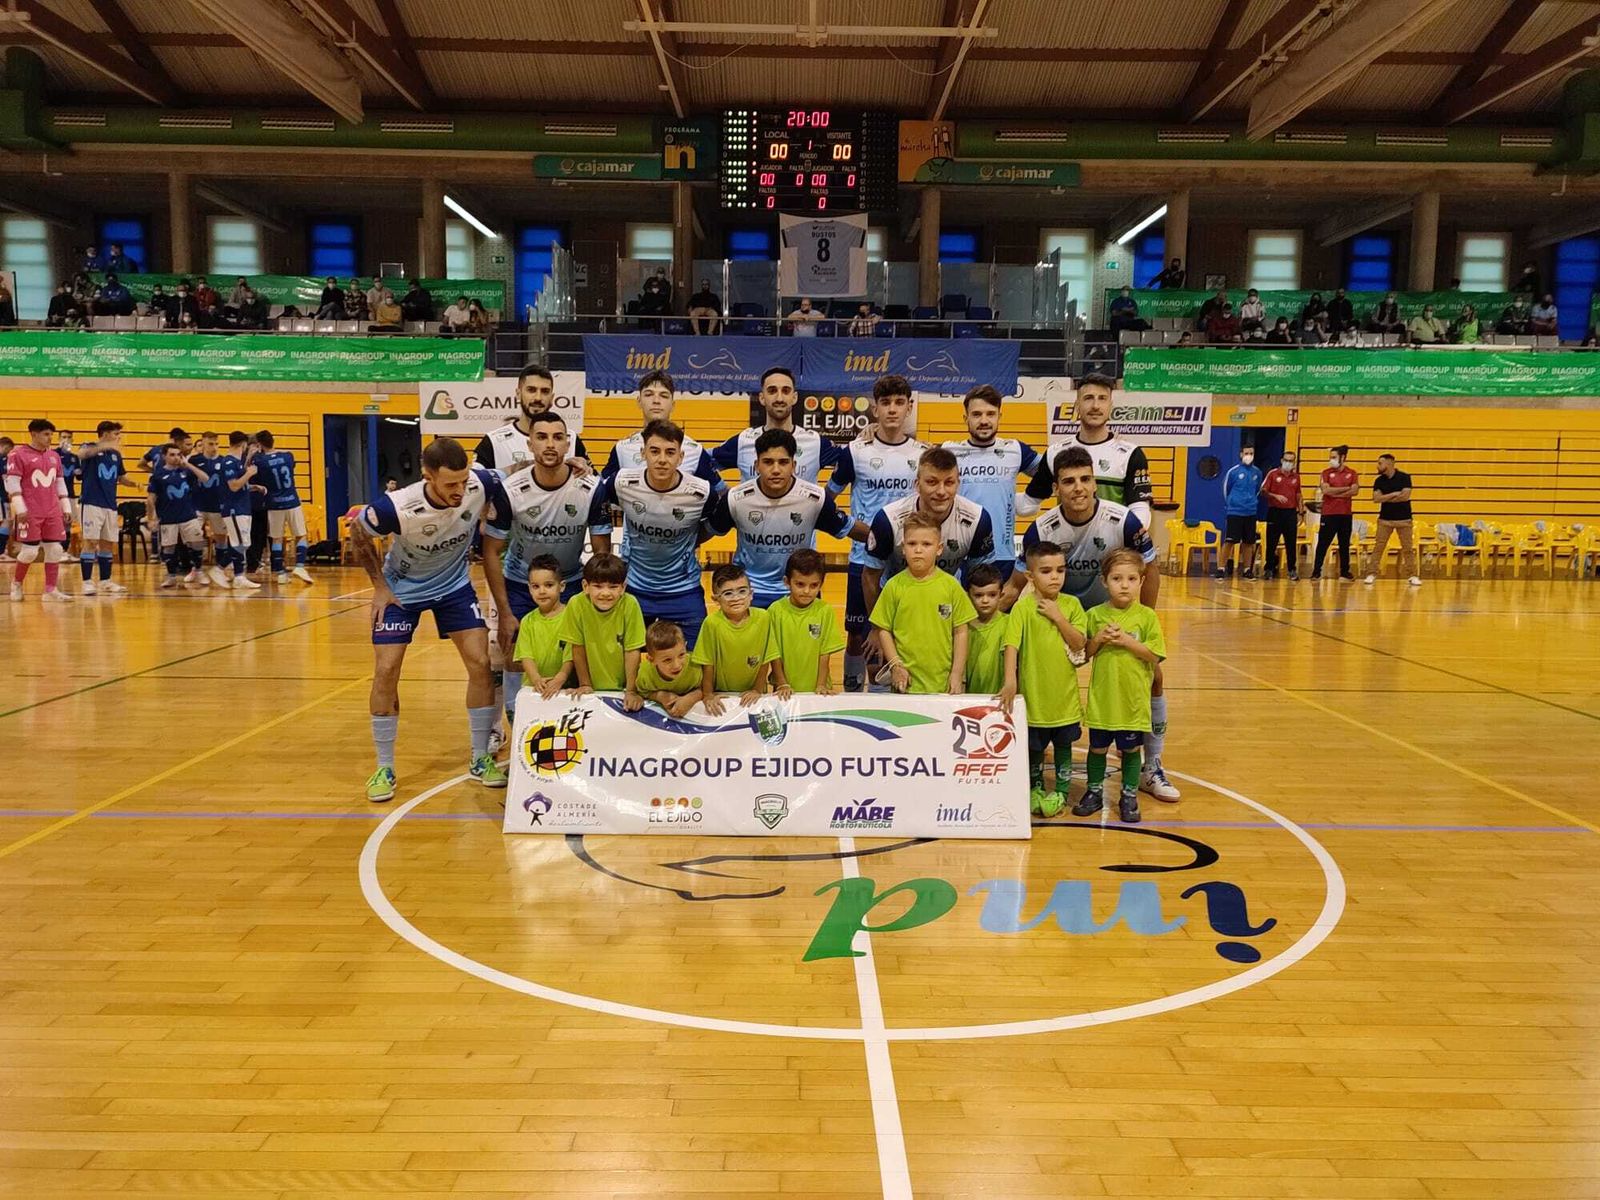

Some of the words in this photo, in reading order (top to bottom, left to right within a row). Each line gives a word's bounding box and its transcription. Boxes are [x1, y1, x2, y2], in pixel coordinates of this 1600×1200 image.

[787, 111, 830, 127] 20:00
[764, 131, 790, 139] LOCAL
[826, 132, 852, 140] VISITANTE
[769, 143, 789, 159] 00
[832, 144, 852, 160] 00
[576, 160, 636, 175] cajamar
[996, 165, 1054, 182] cajamar
[759, 173, 775, 186] 00
[796, 173, 804, 186] 0
[811, 174, 827, 186] 00
[847, 174, 856, 187] 0
[766, 196, 775, 209] 0
[818, 196, 827, 209] 0
[817, 238, 830, 262] 8
[141, 348, 187, 357] INAGROUP
[191, 349, 237, 358] INAGROUP
[241, 350, 286, 359] INAGROUP
[291, 350, 336, 359] INAGROUP
[438, 351, 483, 360] INAGROUP
[625, 347, 672, 370] imd
[844, 349, 892, 372] imd
[1160, 363, 1205, 371] INAGROUP
[1307, 365, 1351, 373] INAGROUP
[1355, 365, 1401, 374] INAGROUP
[1405, 365, 1450, 374] INAGROUP
[1551, 366, 1596, 375] INAGROUP
[803, 414, 821, 429] EL
[825, 414, 869, 429] EJIDO
[1113, 424, 1150, 434] VEHÍCULOS
[1150, 425, 1201, 434] INDUSTRIALES
[271, 467, 292, 489] 13
[744, 533, 806, 546] INAGROUP
[589, 756, 743, 778] INAGROUP
[751, 757, 833, 778] EJIDO
[841, 756, 946, 778] FUTSAL
[648, 811, 664, 823] EL
[666, 811, 703, 823] EJIDO
[936, 803, 972, 822] imd
